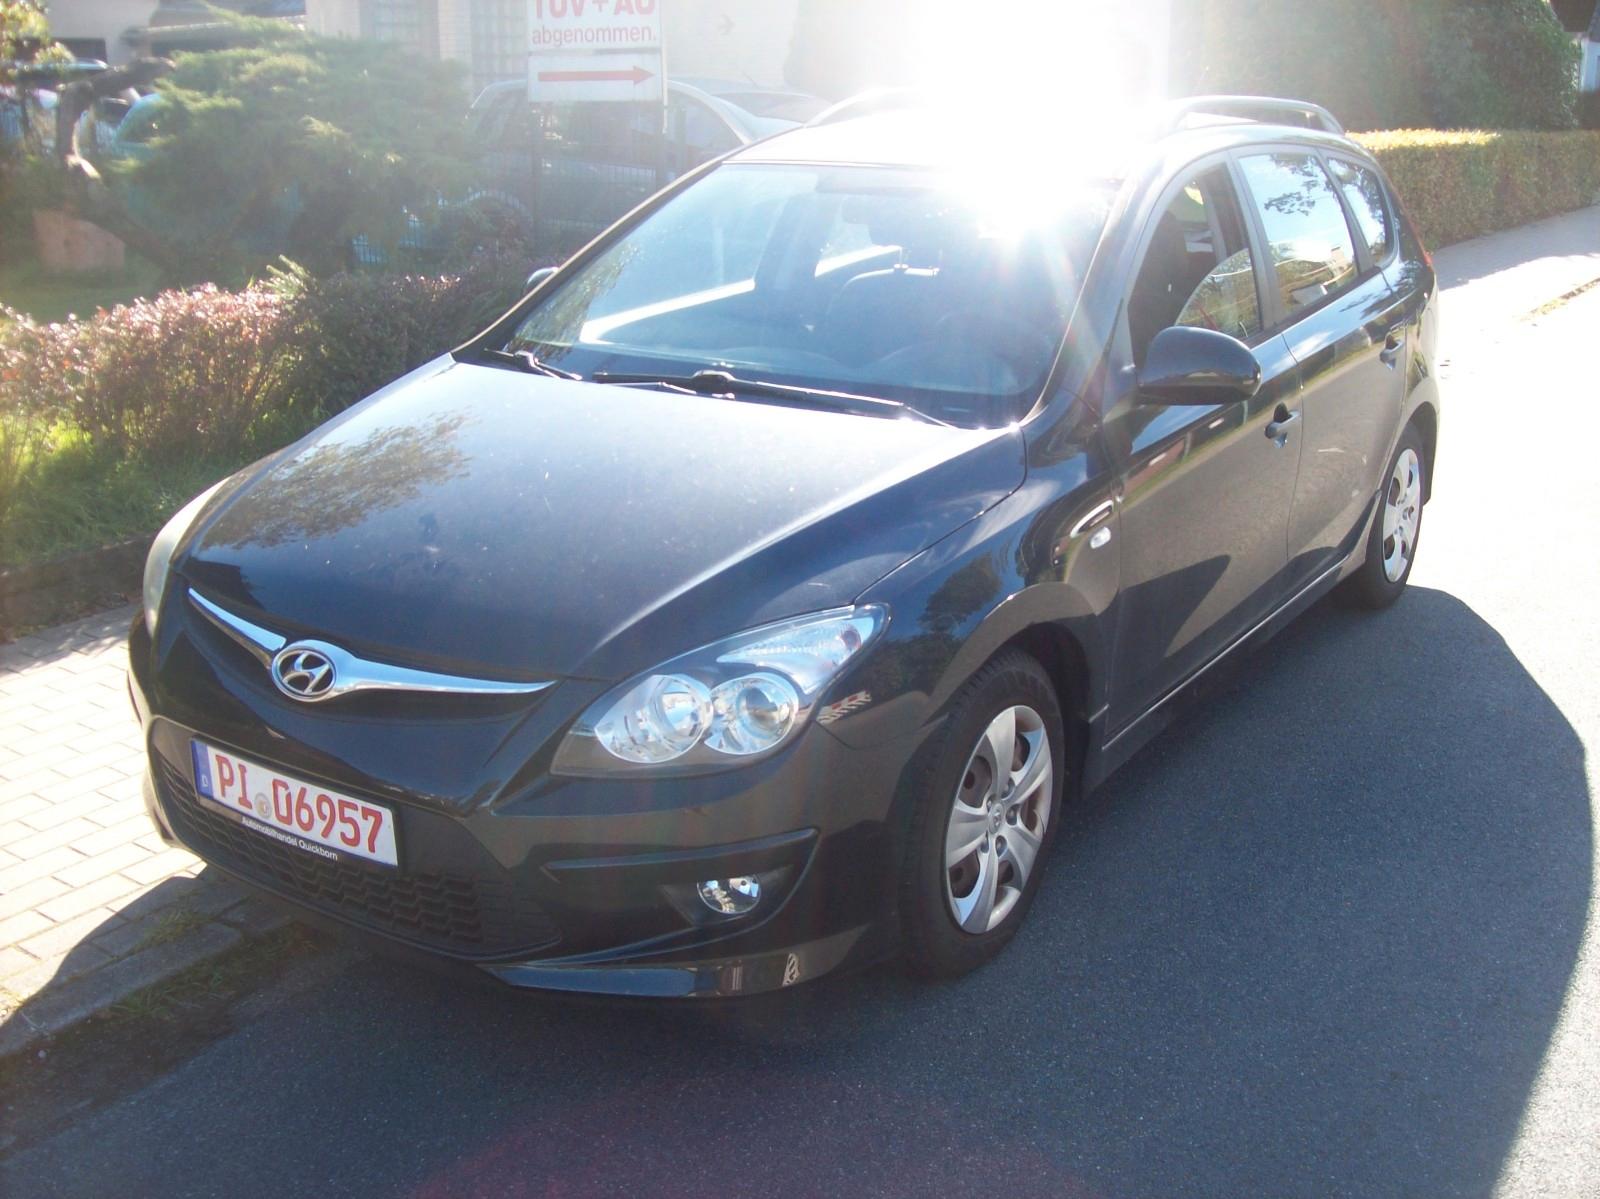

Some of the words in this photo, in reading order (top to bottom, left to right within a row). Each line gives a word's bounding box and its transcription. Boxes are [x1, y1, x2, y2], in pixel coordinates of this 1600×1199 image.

[532, 25, 656, 47] abgenommen.
[242, 816, 298, 847] Automobilhandel
[299, 839, 338, 861] Quickborn
[272, 778, 383, 854] 06957
